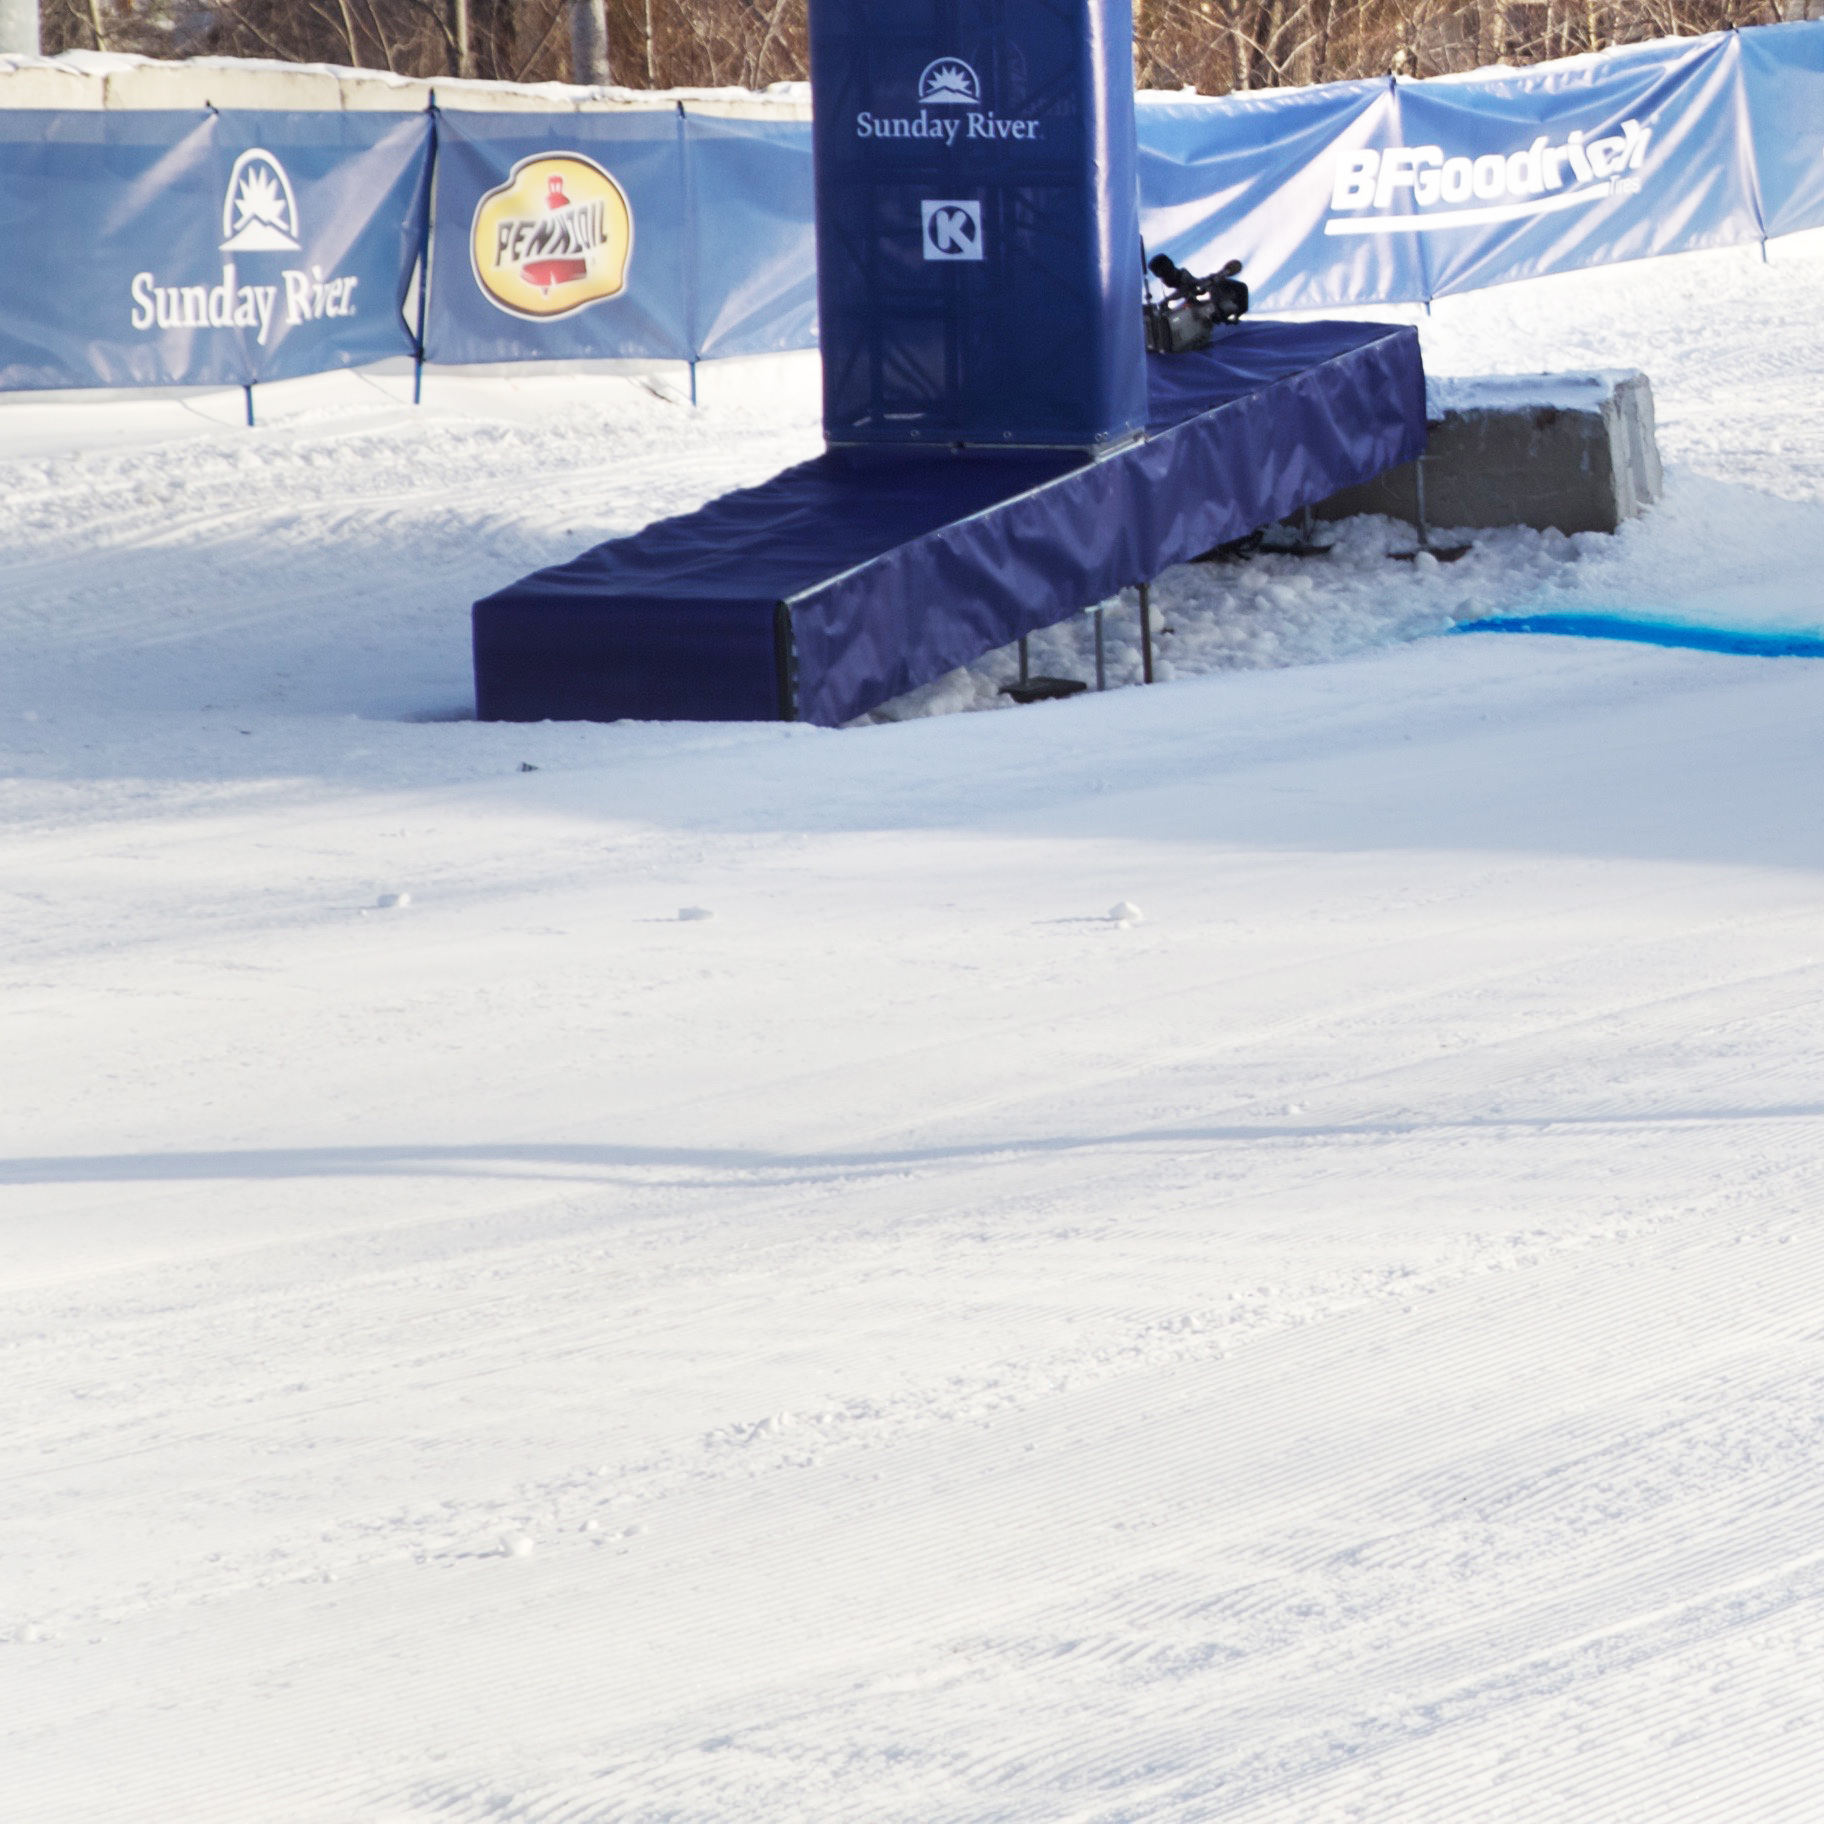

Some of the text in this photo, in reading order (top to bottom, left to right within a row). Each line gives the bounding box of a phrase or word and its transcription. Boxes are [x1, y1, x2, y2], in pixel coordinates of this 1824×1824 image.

[856, 109, 1040, 147] Sunday River
[1331, 118, 1653, 211] BFGoodrich
[1609, 174, 1641, 195] Tires
[493, 200, 609, 269] PENNZOIL
[130, 262, 355, 346] Sunday River
